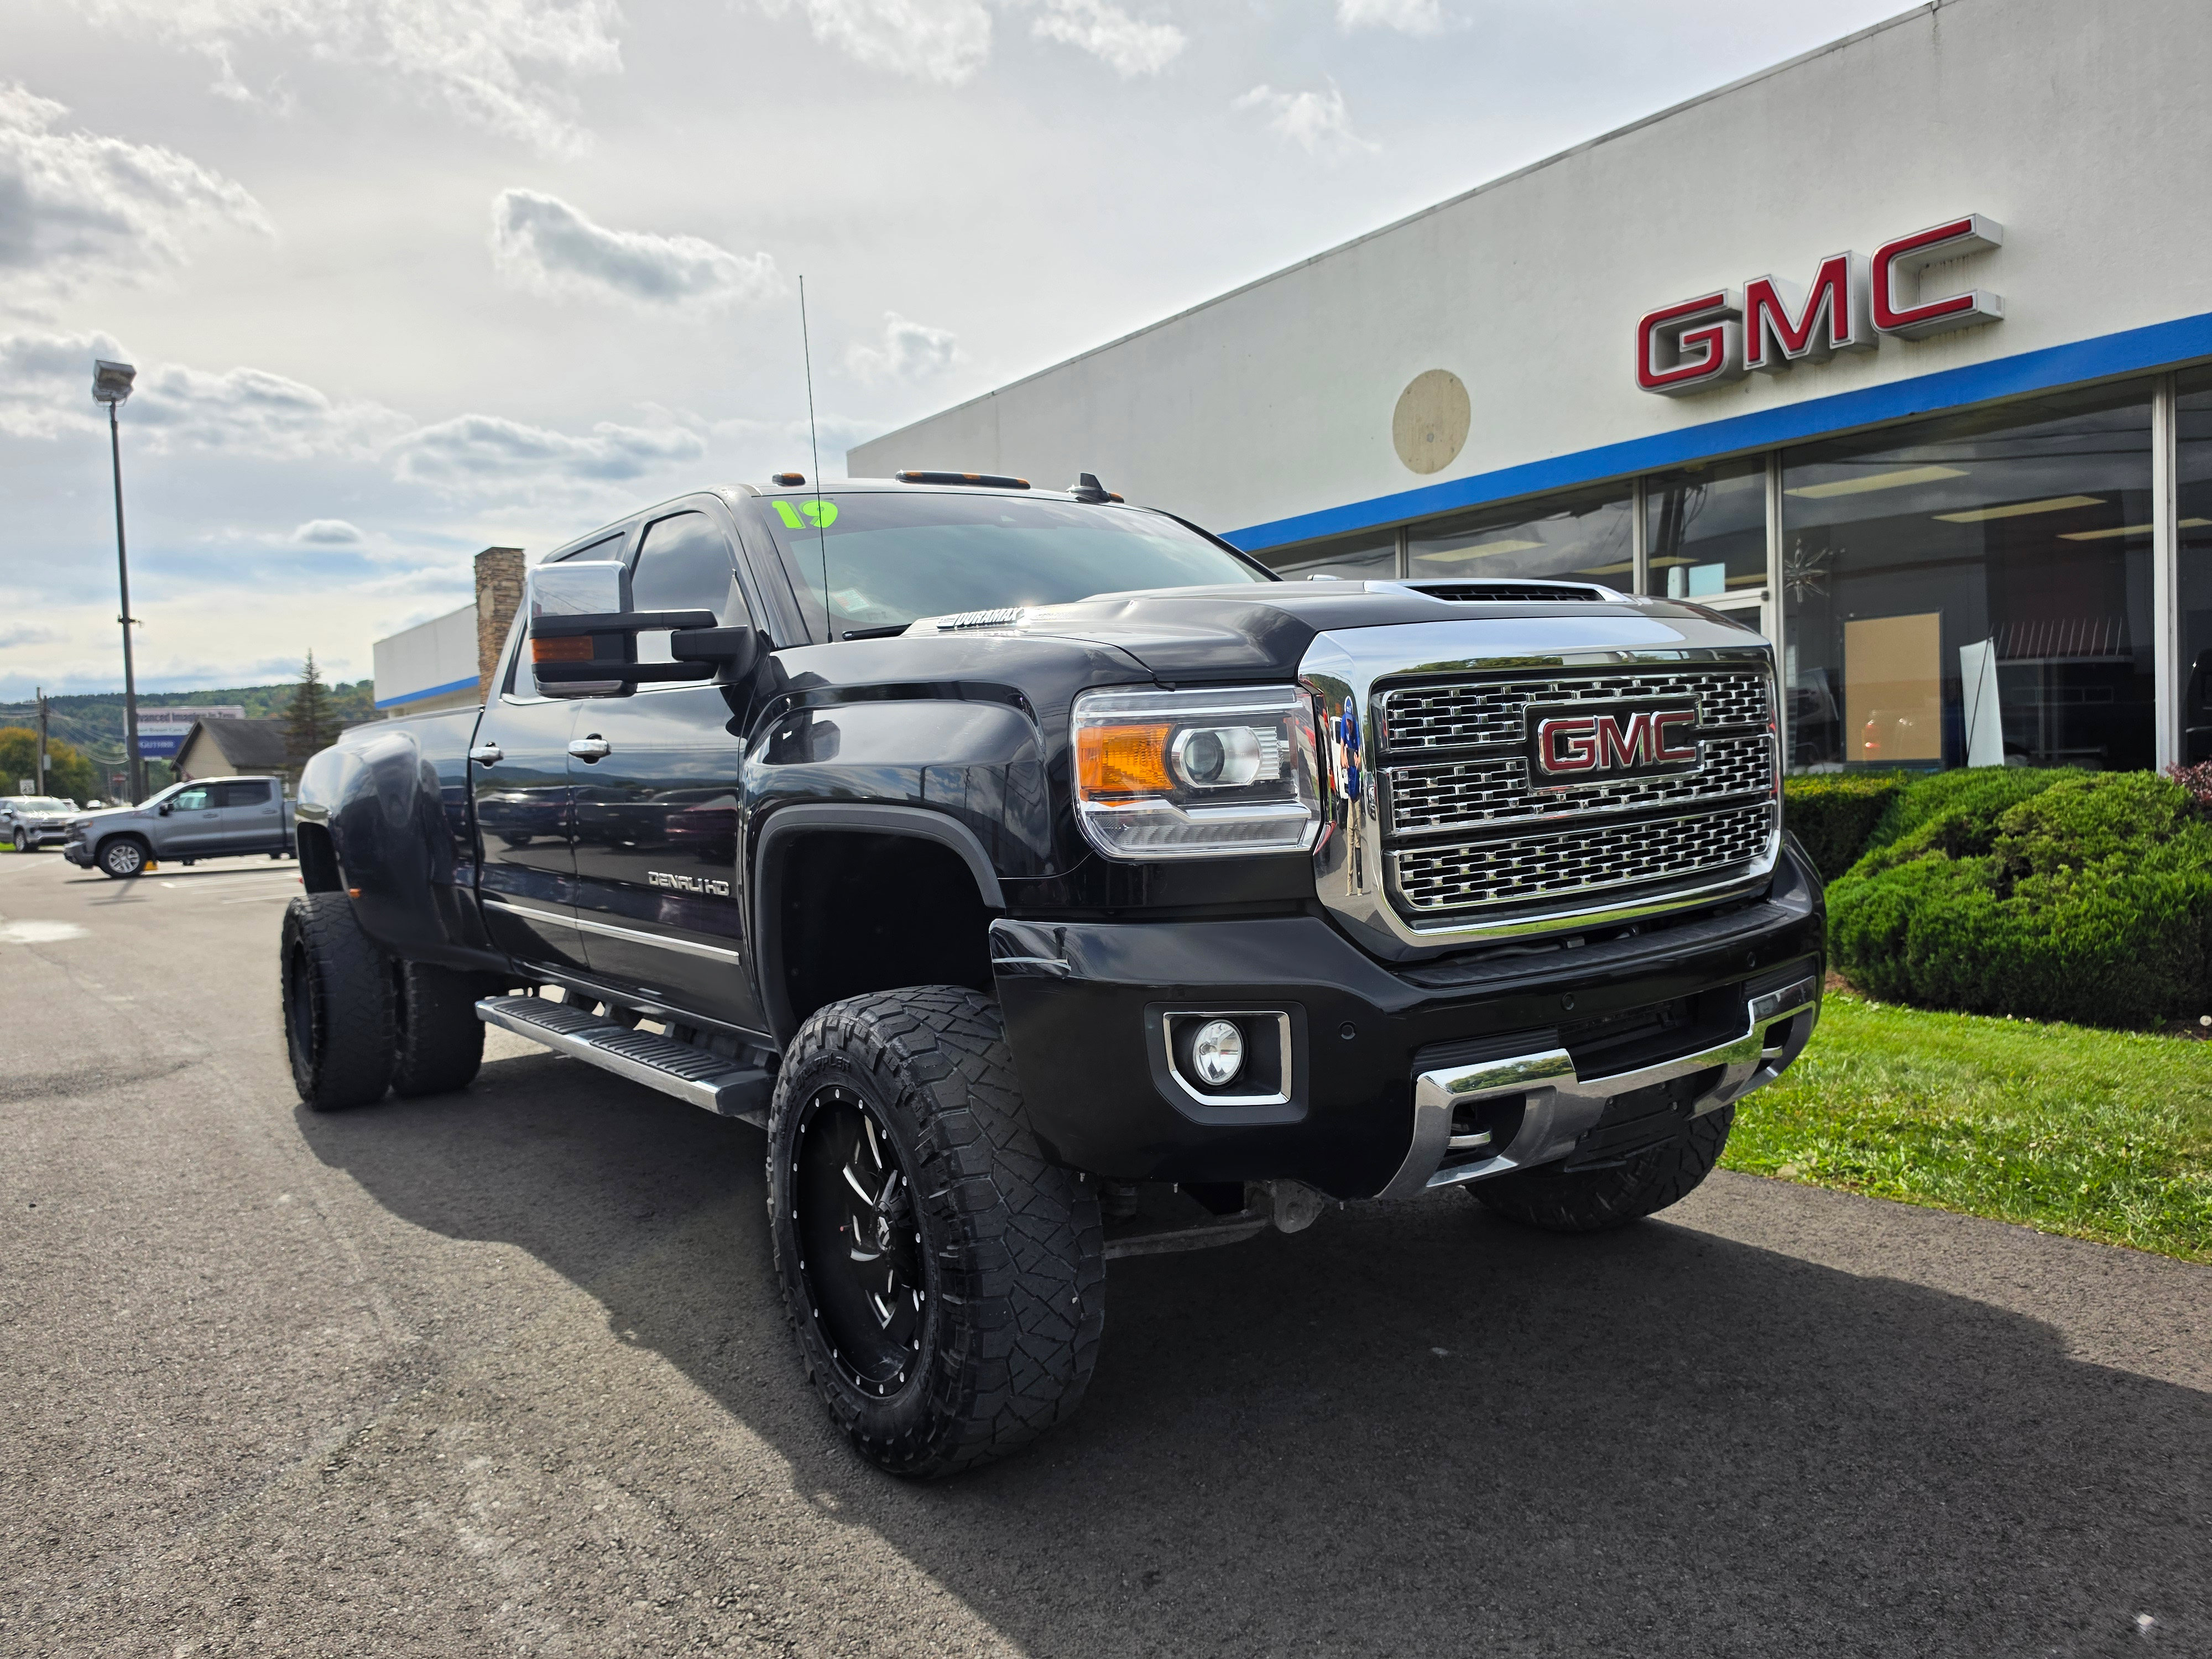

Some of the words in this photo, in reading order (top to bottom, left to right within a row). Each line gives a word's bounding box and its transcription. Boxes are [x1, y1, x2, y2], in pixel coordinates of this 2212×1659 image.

[1635, 213, 2003, 398] GMC
[772, 500, 839, 530] 19
[954, 606, 1024, 626] DURAMAX
[1538, 709, 1697, 775] GMC
[648, 871, 703, 893] DENALI
[704, 878, 730, 896] HD
